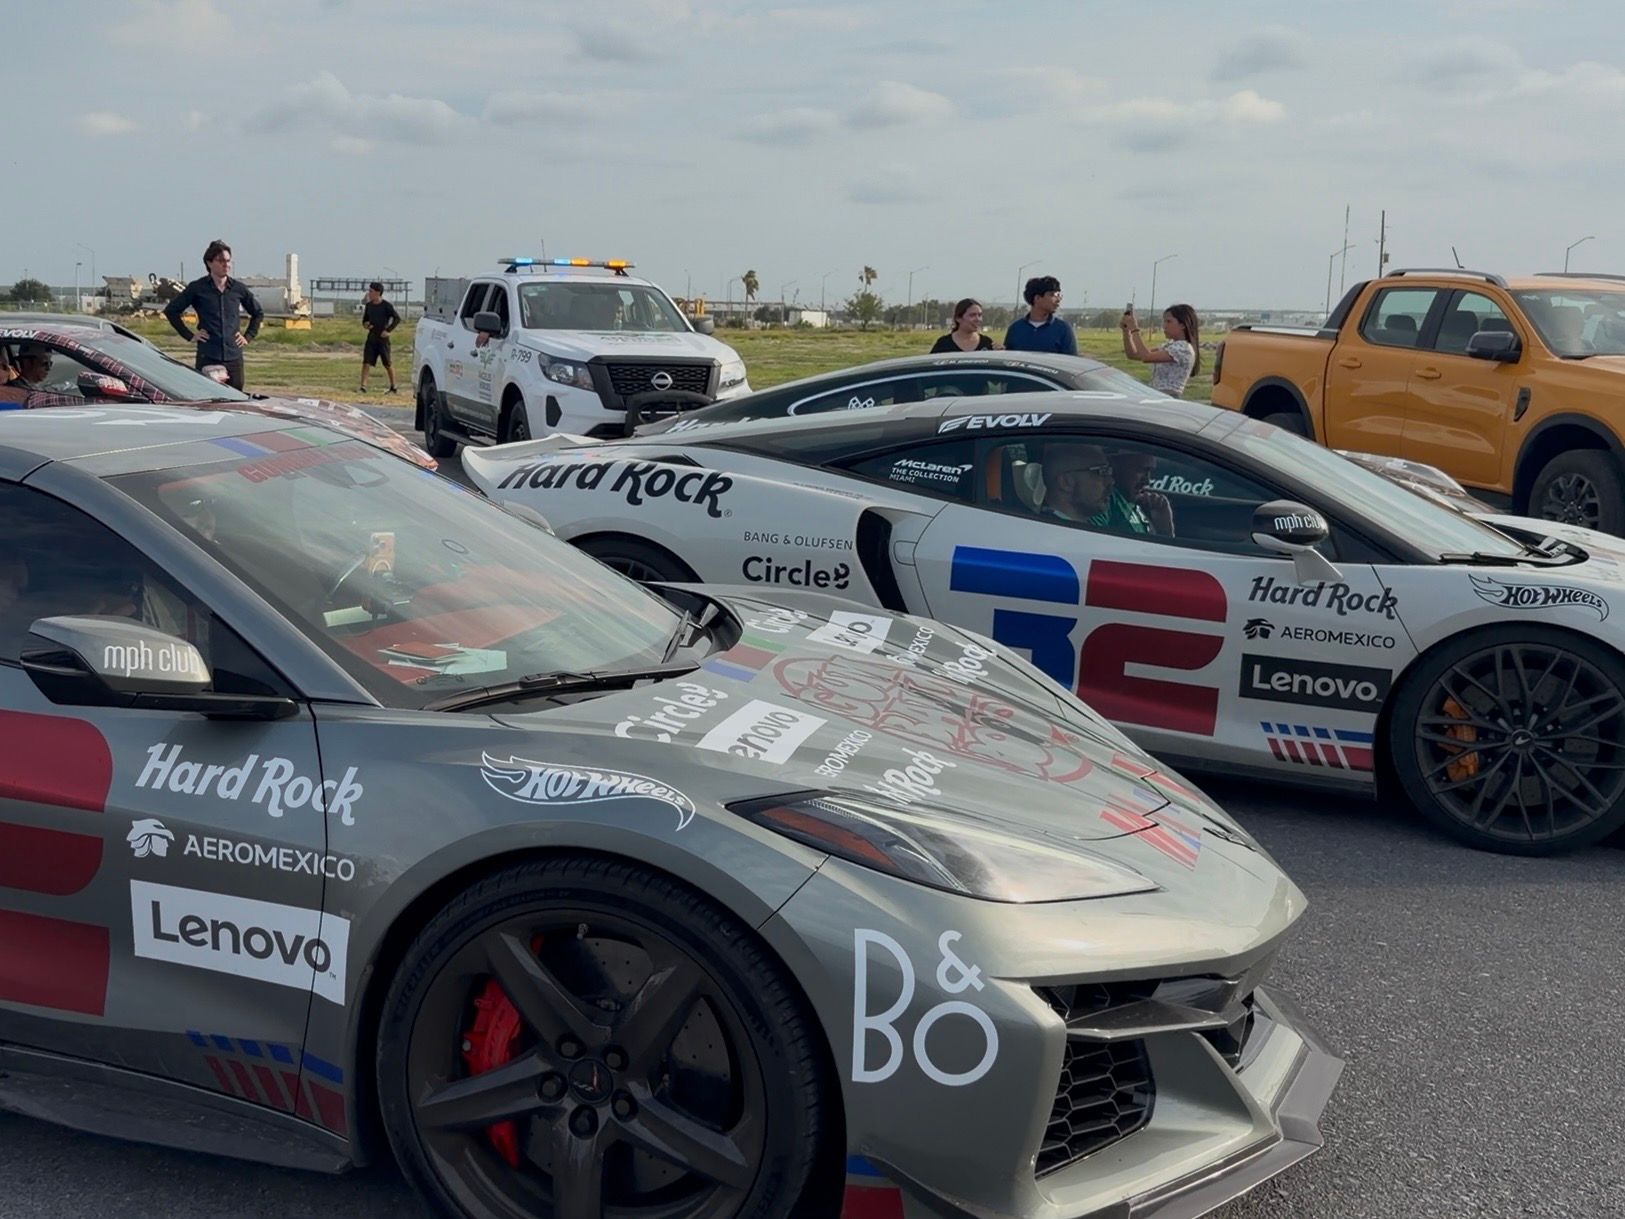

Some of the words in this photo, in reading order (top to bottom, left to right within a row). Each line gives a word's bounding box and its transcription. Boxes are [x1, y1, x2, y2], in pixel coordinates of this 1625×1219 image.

[966, 413, 1052, 429] EVOLV
[889, 474, 915, 483] MIAMI
[892, 467, 907, 475] THE
[908, 470, 960, 484] COLLECTION
[894, 459, 962, 475] McLaren
[1168, 476, 1214, 496] Rock
[497, 461, 616, 490] Hard
[611, 461, 734, 518] Rock
[744, 530, 779, 544] BANG
[783, 535, 792, 546] &
[794, 536, 853, 551] OLUFSEN
[1274, 513, 1303, 533] mph
[1249, 576, 1325, 607] Hard
[1326, 581, 1399, 620] Rock
[1281, 626, 1396, 649] AEROMEXICO
[104, 640, 153, 678] mph
[1252, 664, 1378, 702] Lenovo
[727, 711, 801, 760] enovo
[814, 729, 873, 778] EROMEXICO
[135, 743, 259, 799] Hard
[252, 757, 364, 826] Rock
[183, 834, 356, 882] AEROMEXICO
[151, 900, 332, 974] Lenovo
